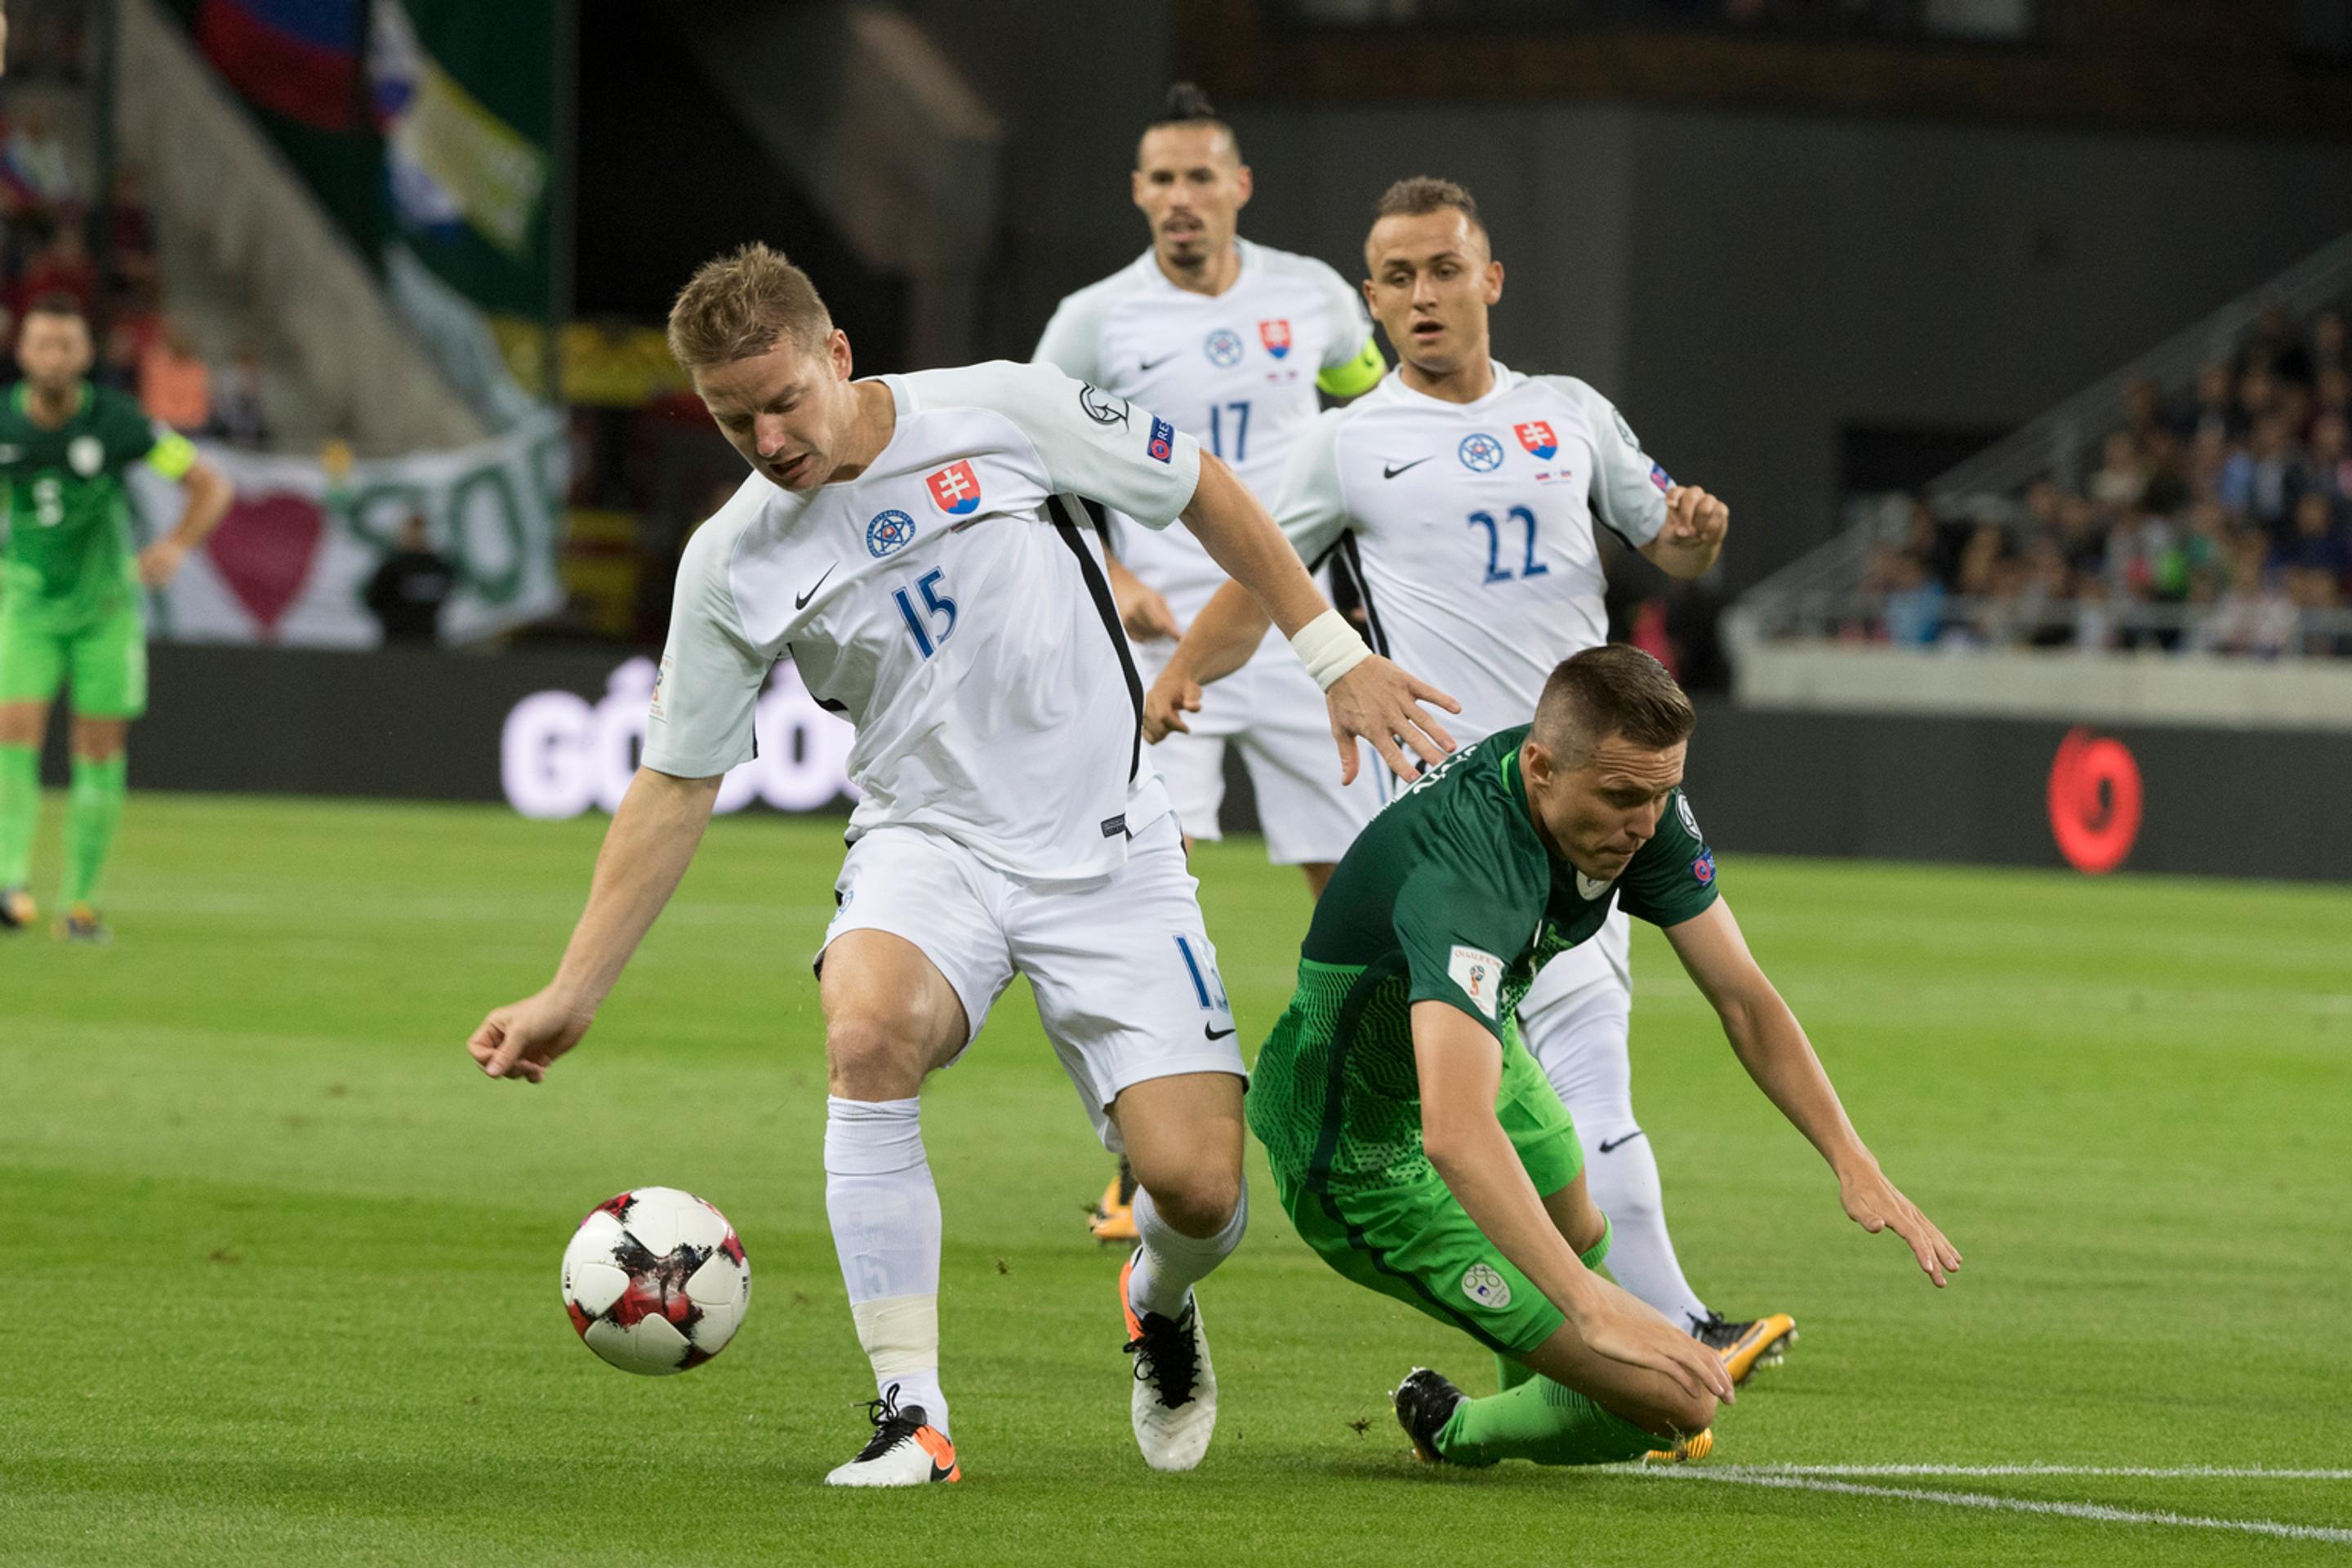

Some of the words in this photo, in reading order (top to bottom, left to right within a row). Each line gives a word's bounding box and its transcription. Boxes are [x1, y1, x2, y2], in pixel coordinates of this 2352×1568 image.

[1209, 400, 1250, 463] 17
[1465, 504, 1549, 587] 22
[891, 564, 958, 662] 15
